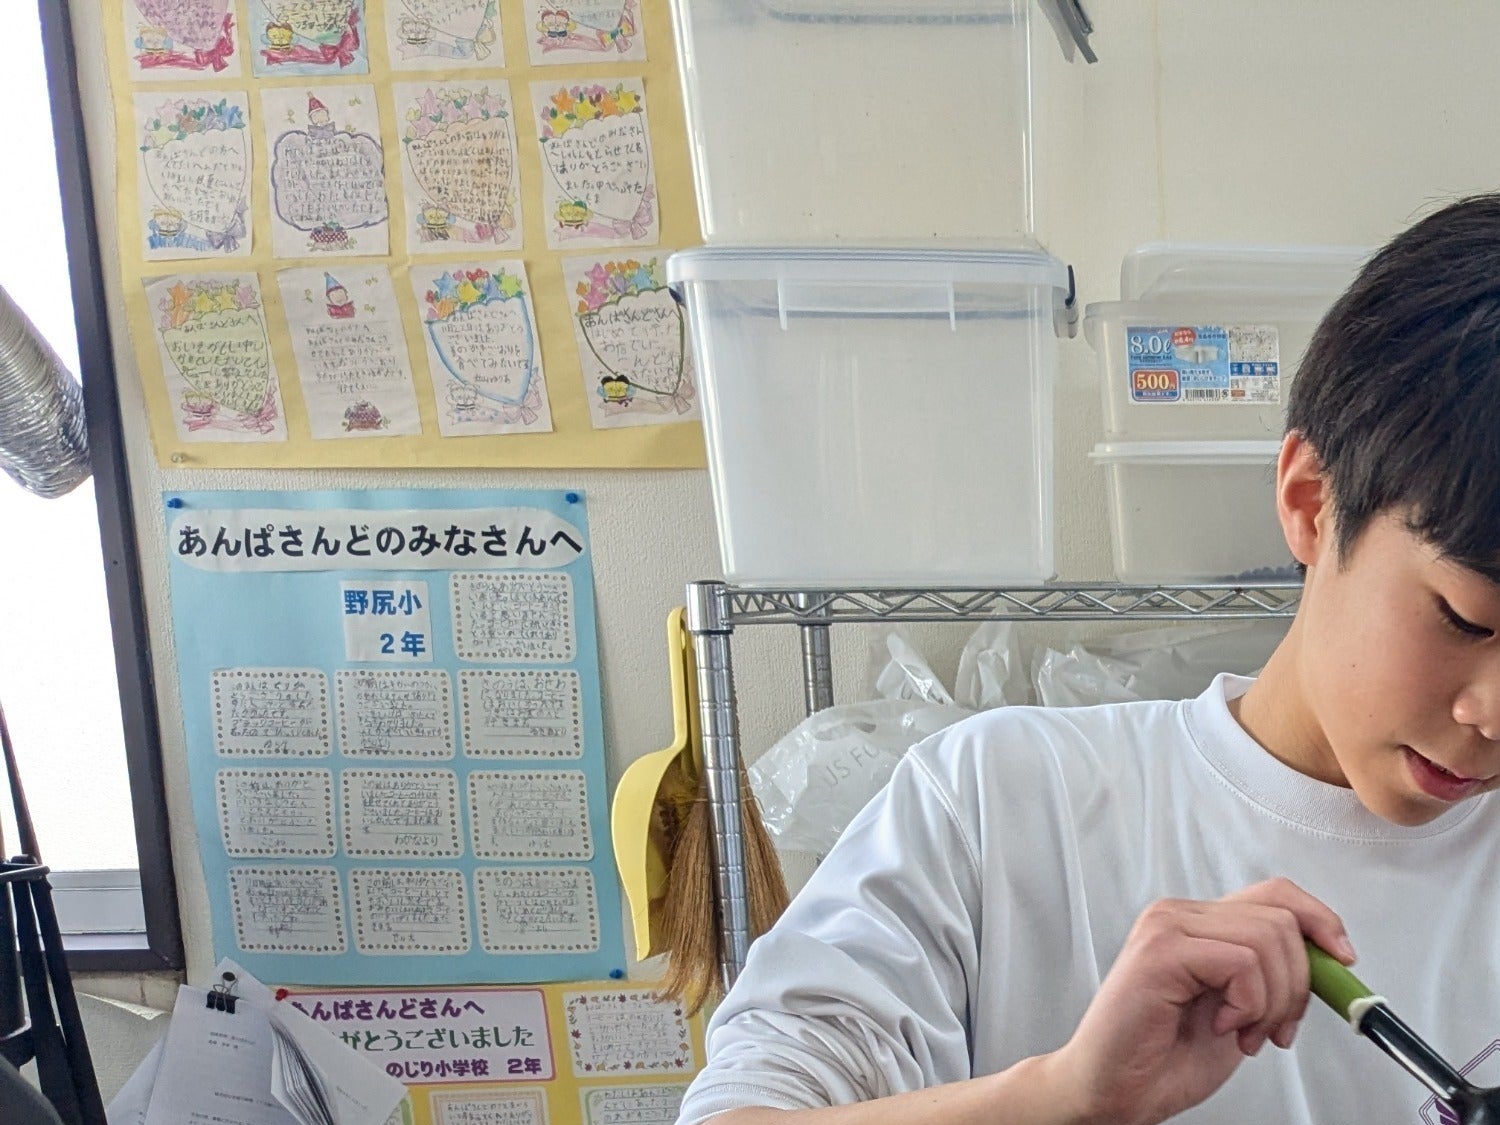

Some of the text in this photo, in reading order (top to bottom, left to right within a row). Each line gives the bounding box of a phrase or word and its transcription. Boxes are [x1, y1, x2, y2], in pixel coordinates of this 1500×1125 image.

[178, 524, 583, 557] あんぱさんどのみなさんへ
[343, 589, 422, 615] 野尻小
[380, 631, 426, 657] 2年
[292, 997, 485, 1021] んぱさんどさんへ
[386, 1059, 490, 1078] のじり小学校
